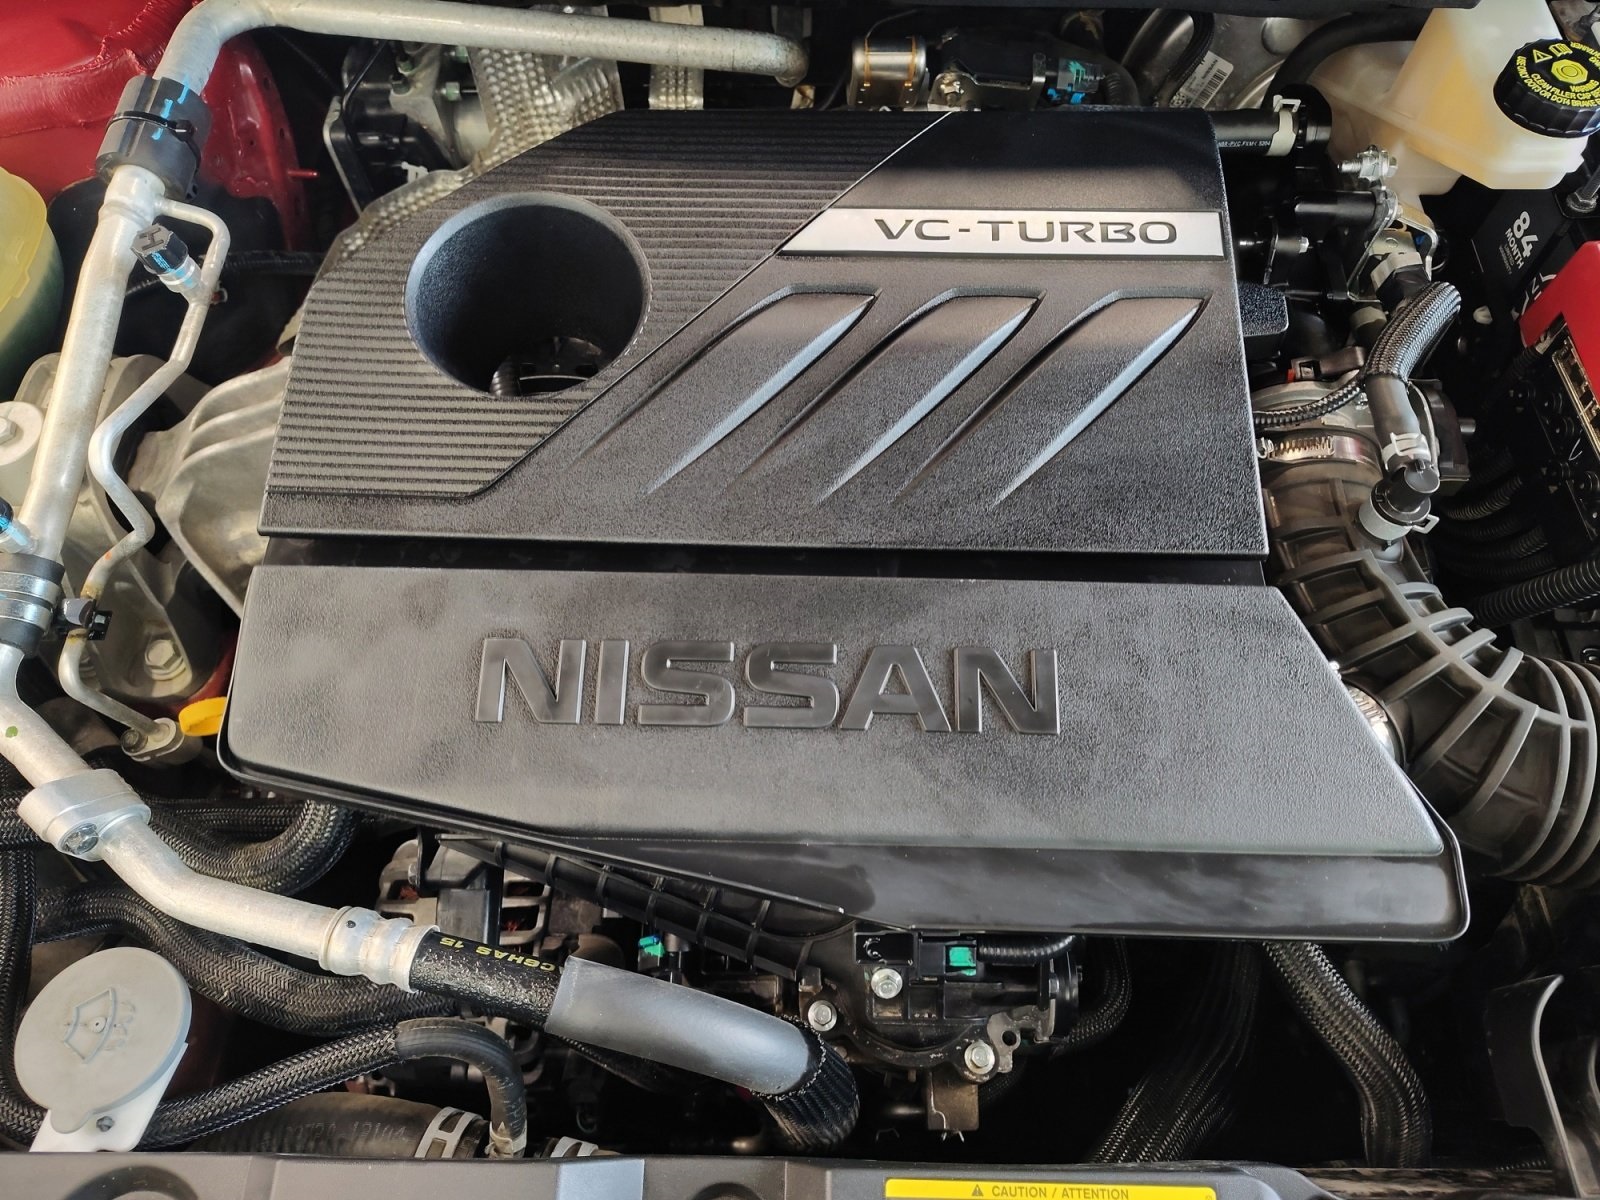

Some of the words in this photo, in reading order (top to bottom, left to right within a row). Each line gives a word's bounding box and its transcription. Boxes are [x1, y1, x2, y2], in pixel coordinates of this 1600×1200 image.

[1531, 73, 1552, 90] CLEAN
[1550, 87, 1576, 99] FILLER
[1539, 90, 1552, 99] OR
[1550, 94, 1570, 106] DOT4
[874, 219, 1177, 244] VC-TURBO
[1513, 211, 1538, 258] 84
[1505, 227, 1524, 269] MONTH
[475, 638, 1061, 736] NISSAN
[991, 1185, 1047, 1198] CAUTION
[1061, 1187, 1129, 1200] ATTENTION
